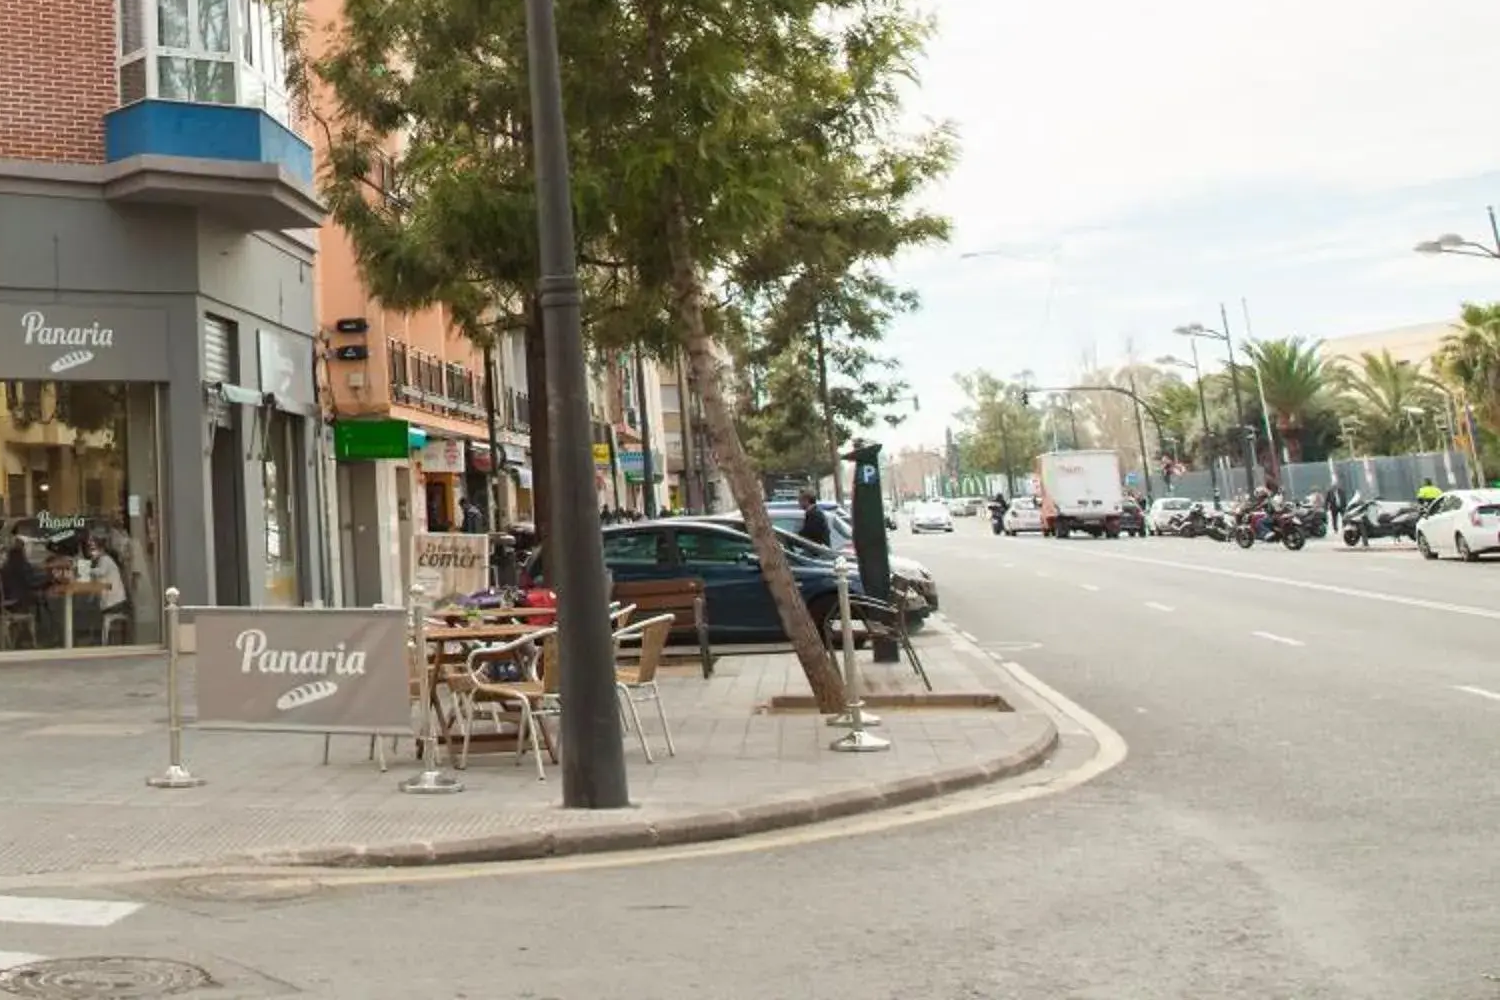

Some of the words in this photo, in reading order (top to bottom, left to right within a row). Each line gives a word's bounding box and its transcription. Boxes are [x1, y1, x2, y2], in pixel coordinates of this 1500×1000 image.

[21, 310, 114, 347] Panaria
[863, 464, 876, 484] P
[37, 509, 85, 529] Panaria
[235, 628, 367, 675] Panaria
